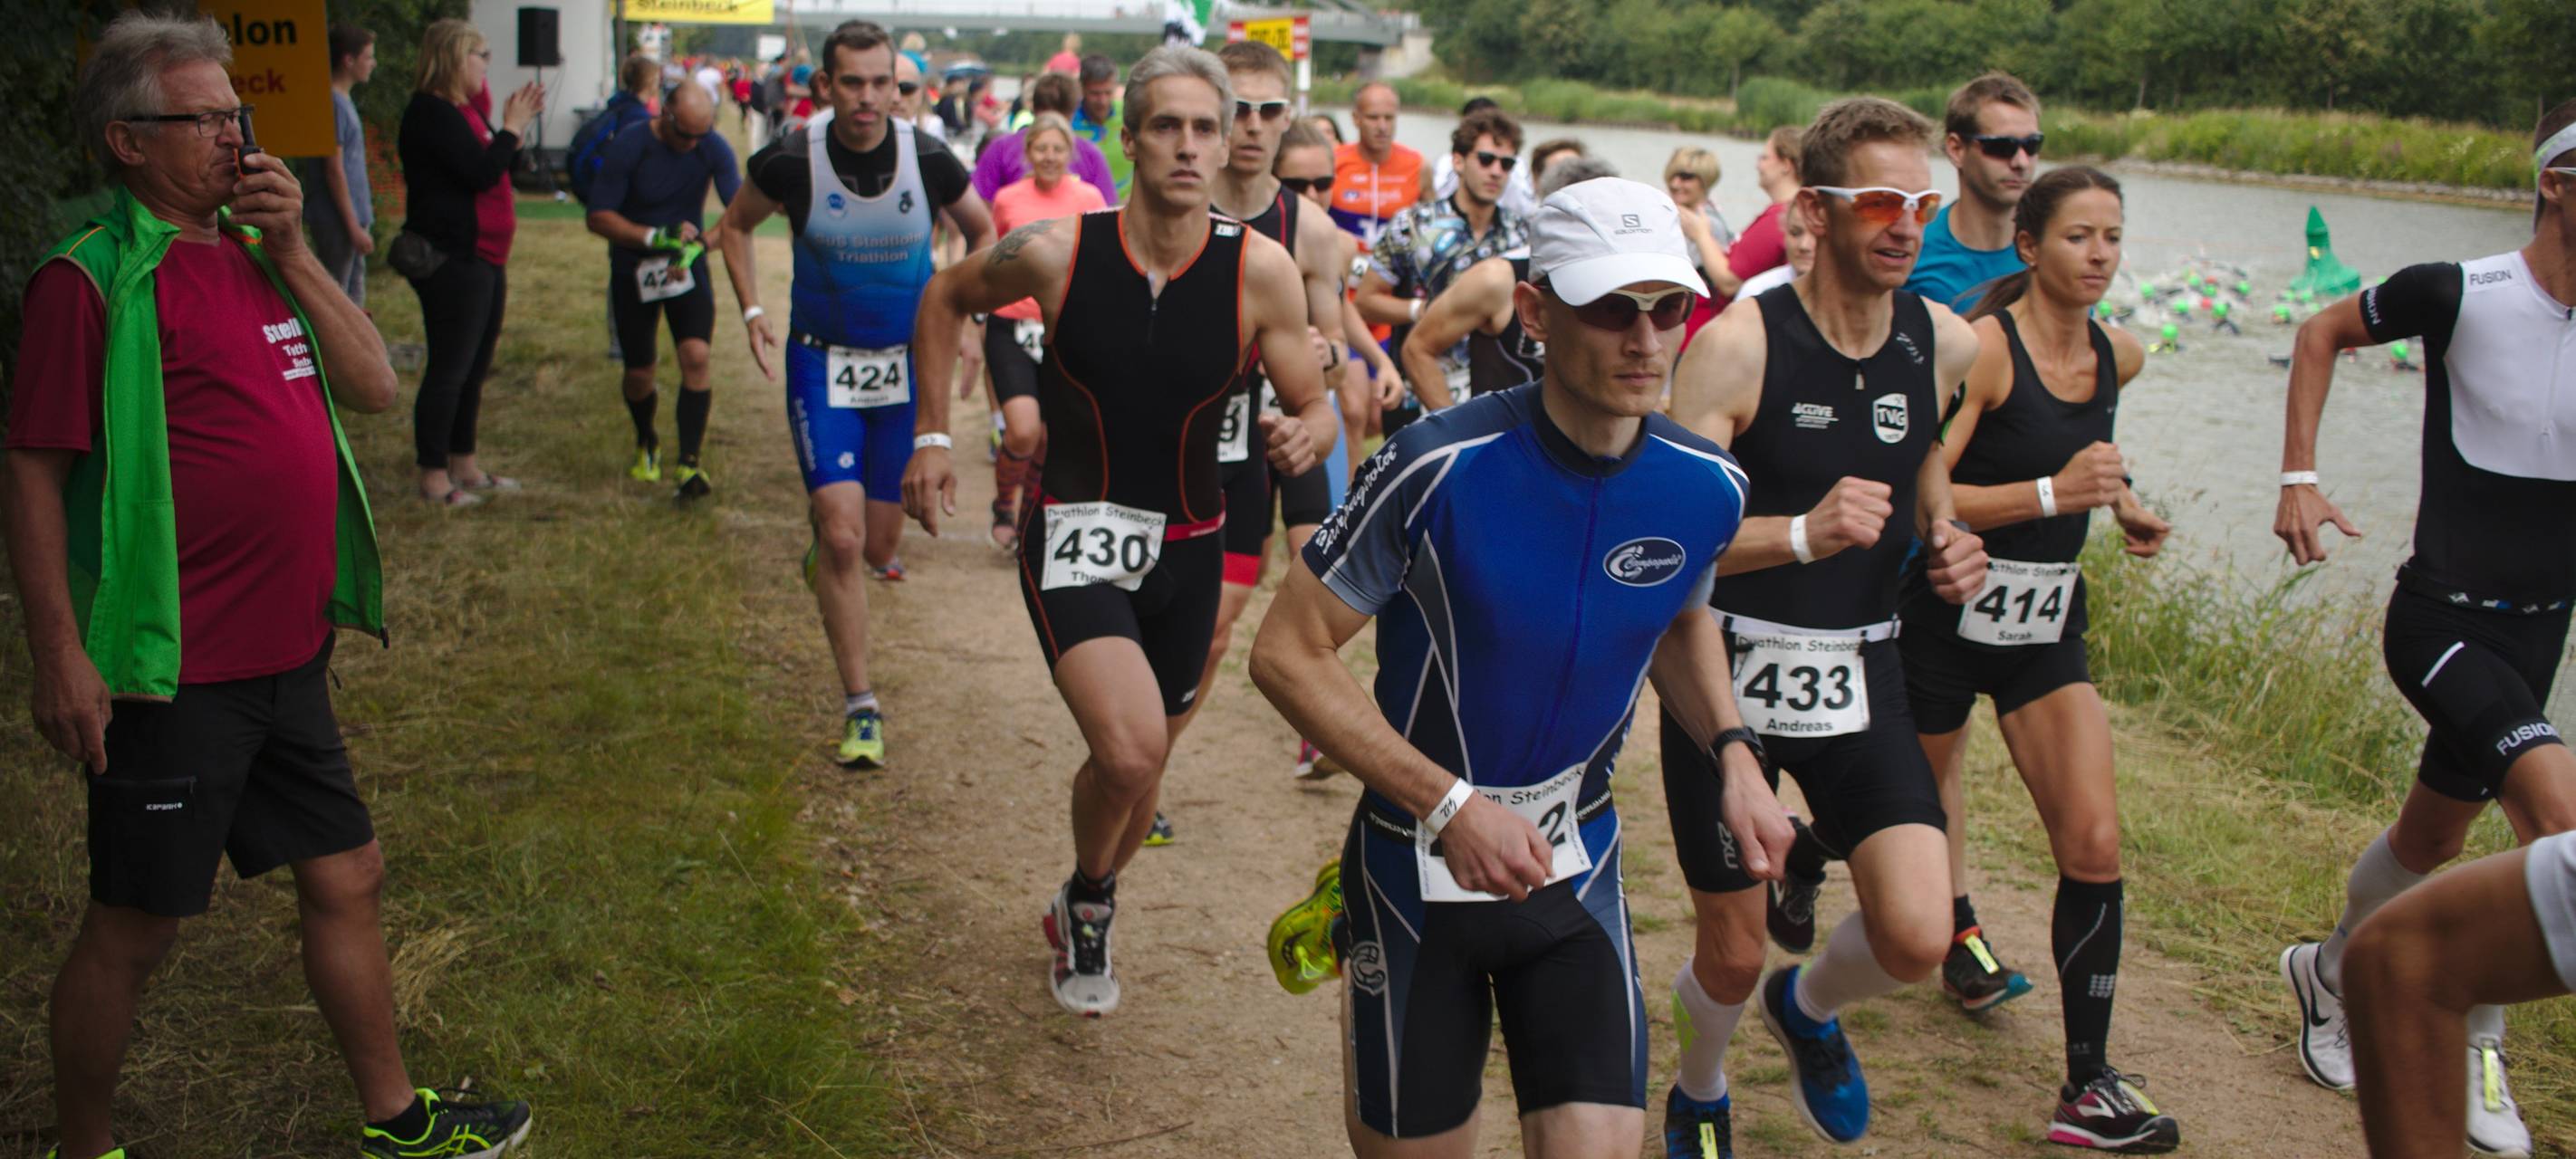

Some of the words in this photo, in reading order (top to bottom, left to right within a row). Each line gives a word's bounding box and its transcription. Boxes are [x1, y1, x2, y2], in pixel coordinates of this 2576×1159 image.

[2469, 270, 2513, 286] FUSION
[835, 362, 902, 391] 424
[1877, 407, 1907, 427] TVG
[1053, 526, 1150, 574] 430
[1973, 585, 2063, 624] 414
[1997, 630, 2033, 641] Sarah
[1744, 663, 1854, 712] 433
[1766, 718, 1834, 733] Andreas
